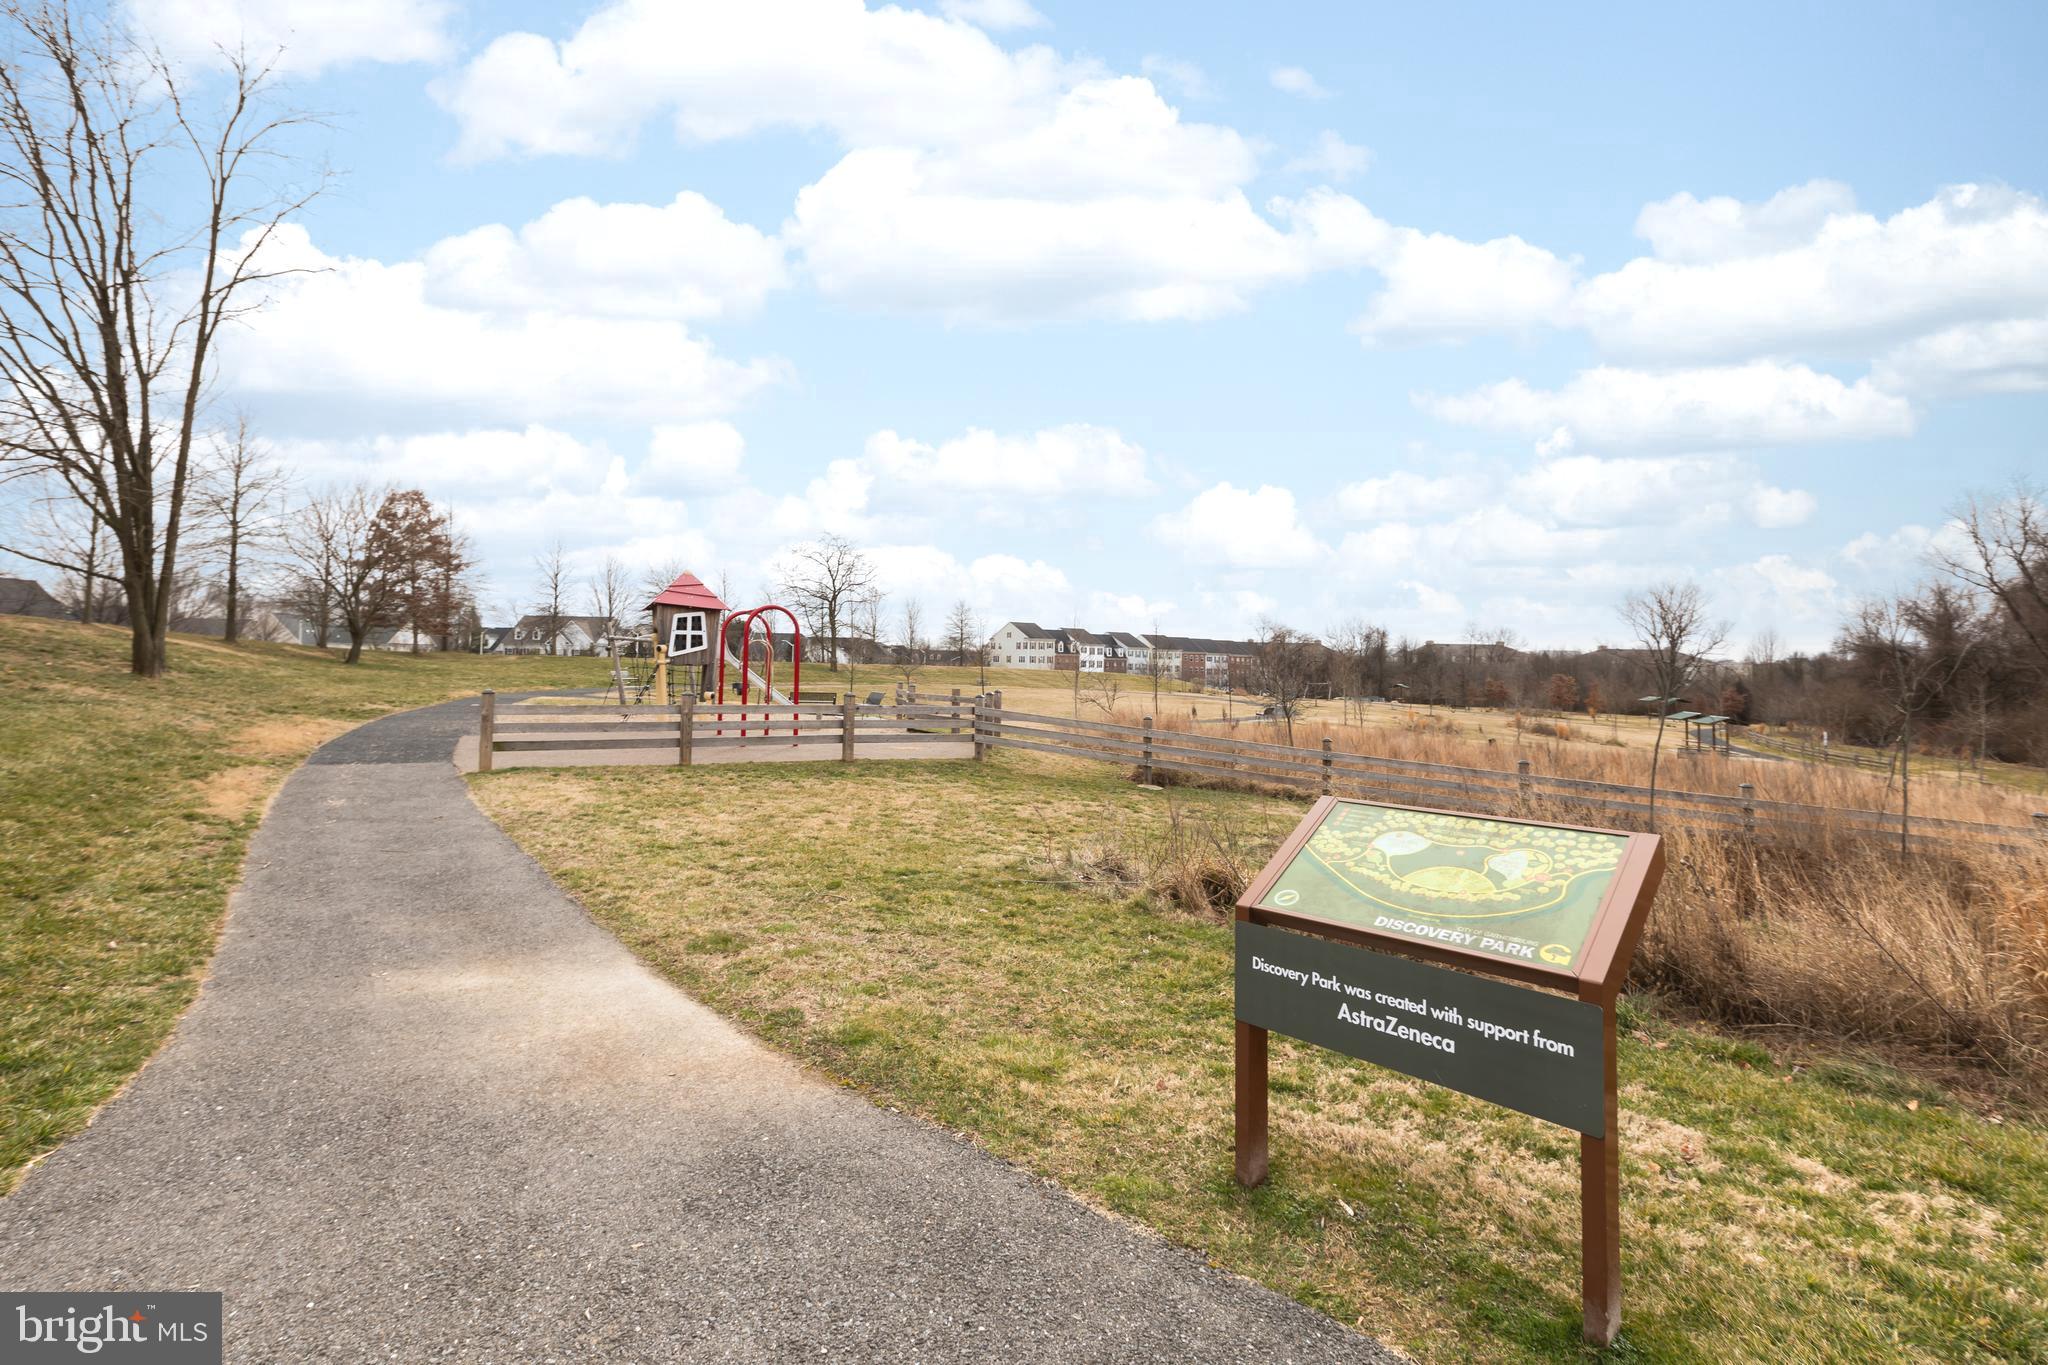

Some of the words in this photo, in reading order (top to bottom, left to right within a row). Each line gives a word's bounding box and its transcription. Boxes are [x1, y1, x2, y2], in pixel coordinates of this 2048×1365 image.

[1374, 916, 1477, 945] DISCOVERY
[1480, 937, 1536, 958] PARK
[1252, 956, 1309, 986] Discovery
[1311, 972, 1341, 992] Park
[1344, 984, 1372, 1000] was
[1375, 994, 1427, 1015] created
[1430, 1006, 1463, 1026] with
[1467, 1017, 1529, 1044] support
[1533, 1029, 1575, 1057] from
[1337, 1003, 1455, 1053] AstraZeneca
